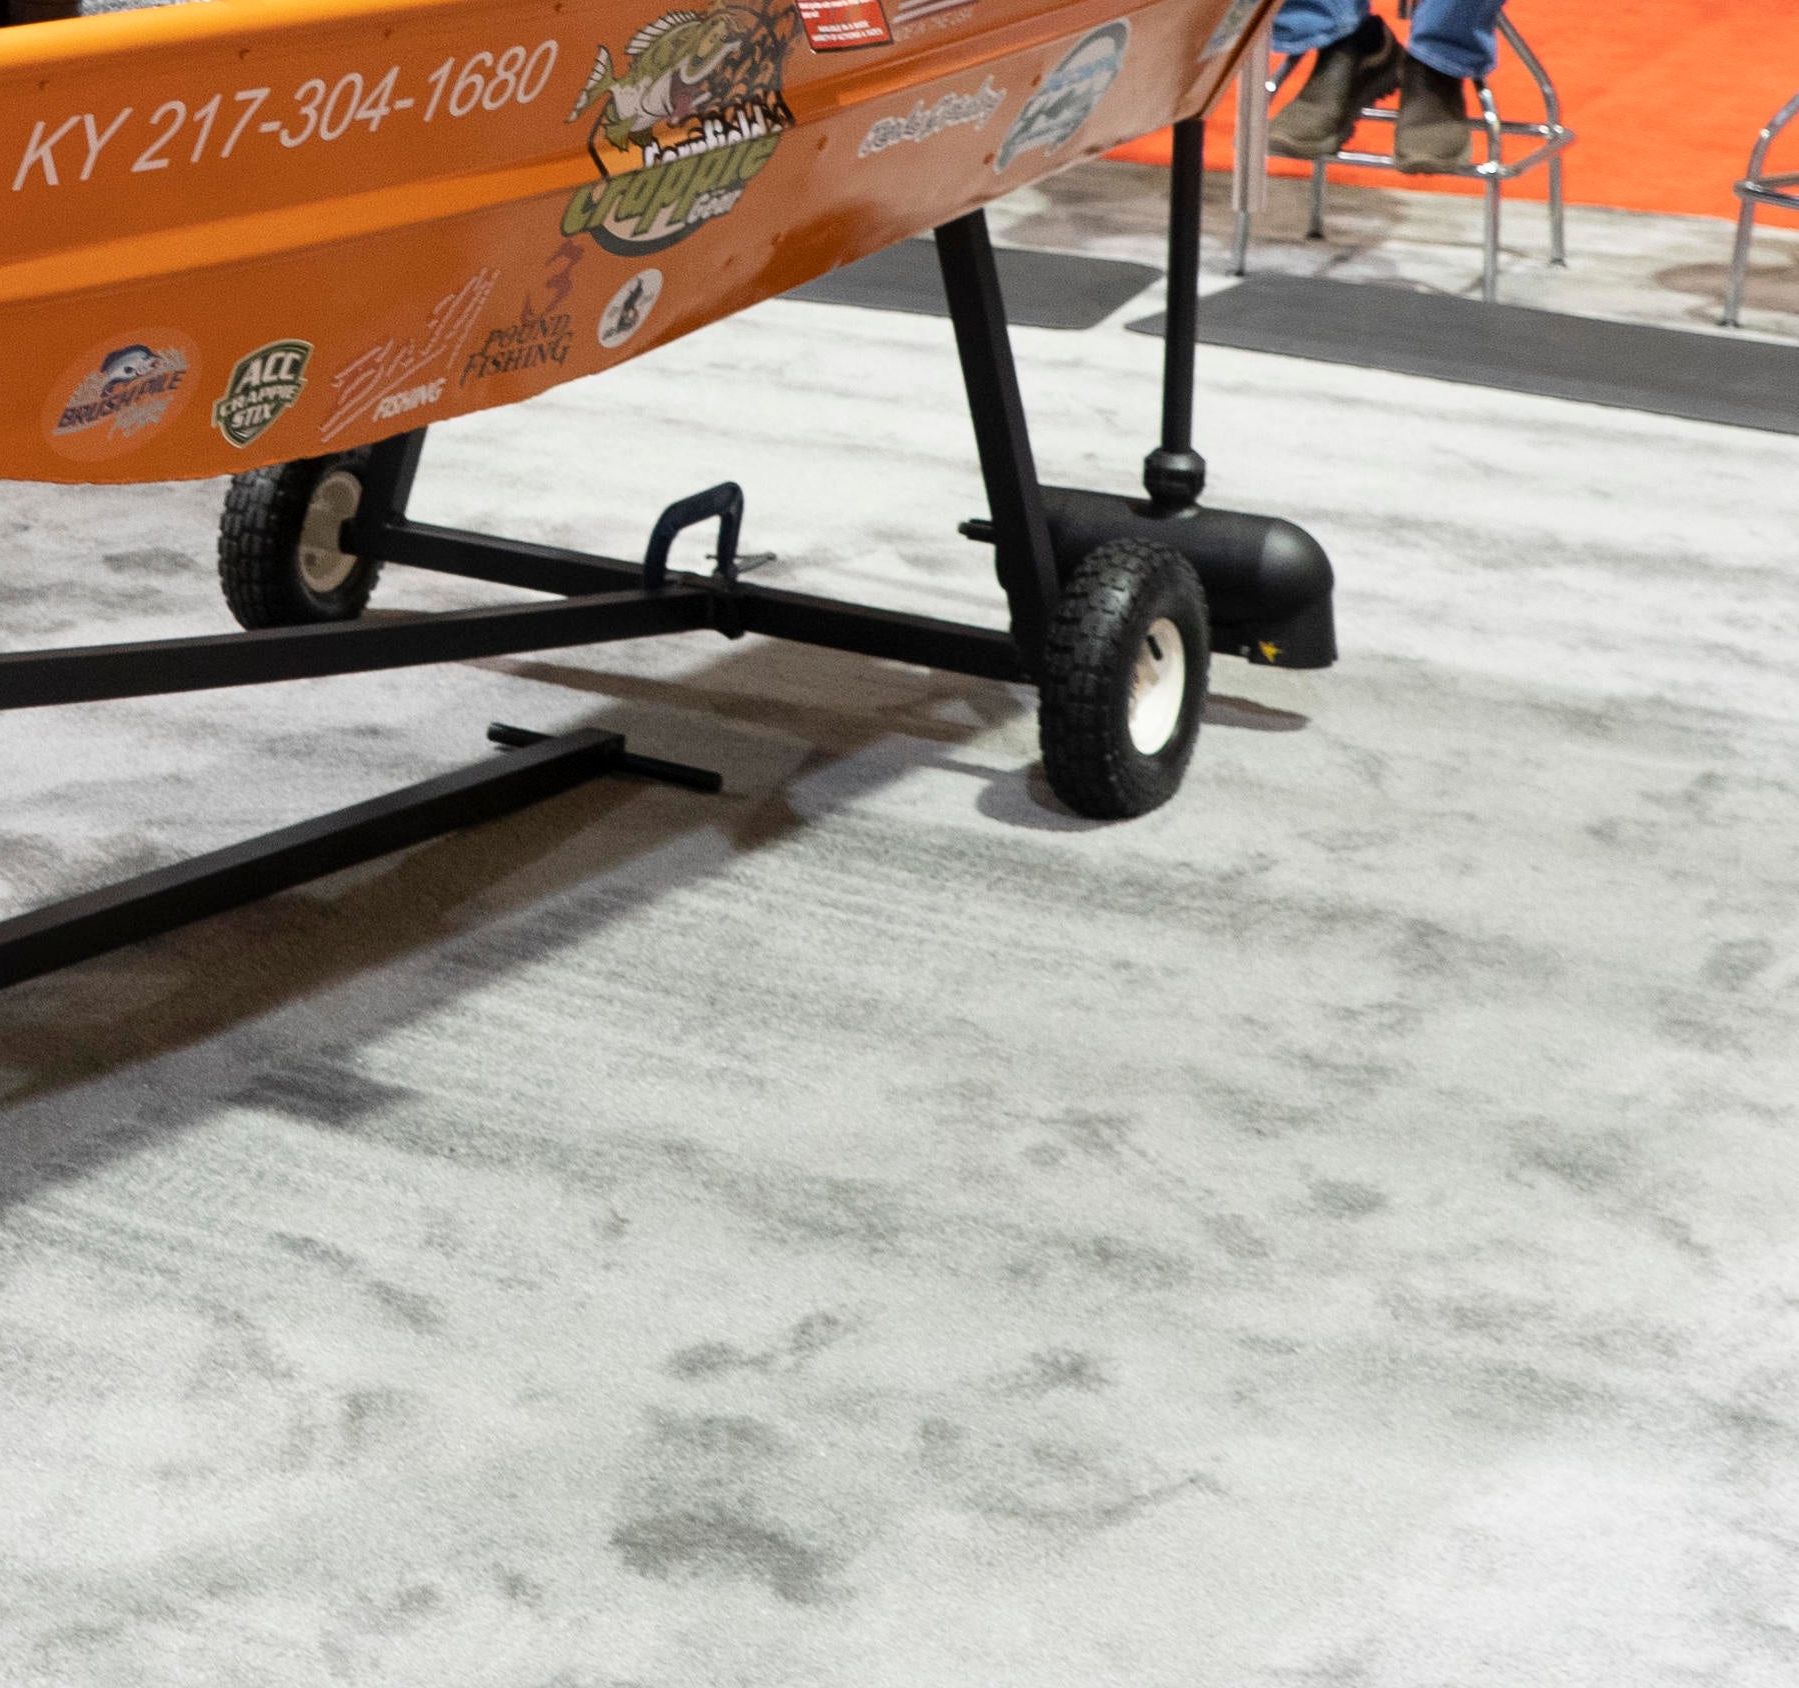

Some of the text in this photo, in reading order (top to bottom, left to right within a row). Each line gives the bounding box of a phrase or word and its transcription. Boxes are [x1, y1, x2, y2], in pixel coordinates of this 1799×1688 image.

[11, 38, 560, 193] KY 217-304-1680
[559, 132, 783, 237] Crappie
[235, 350, 301, 394] ACC
[459, 342, 569, 389] FISHING
[218, 383, 300, 419] CRAPPIE
